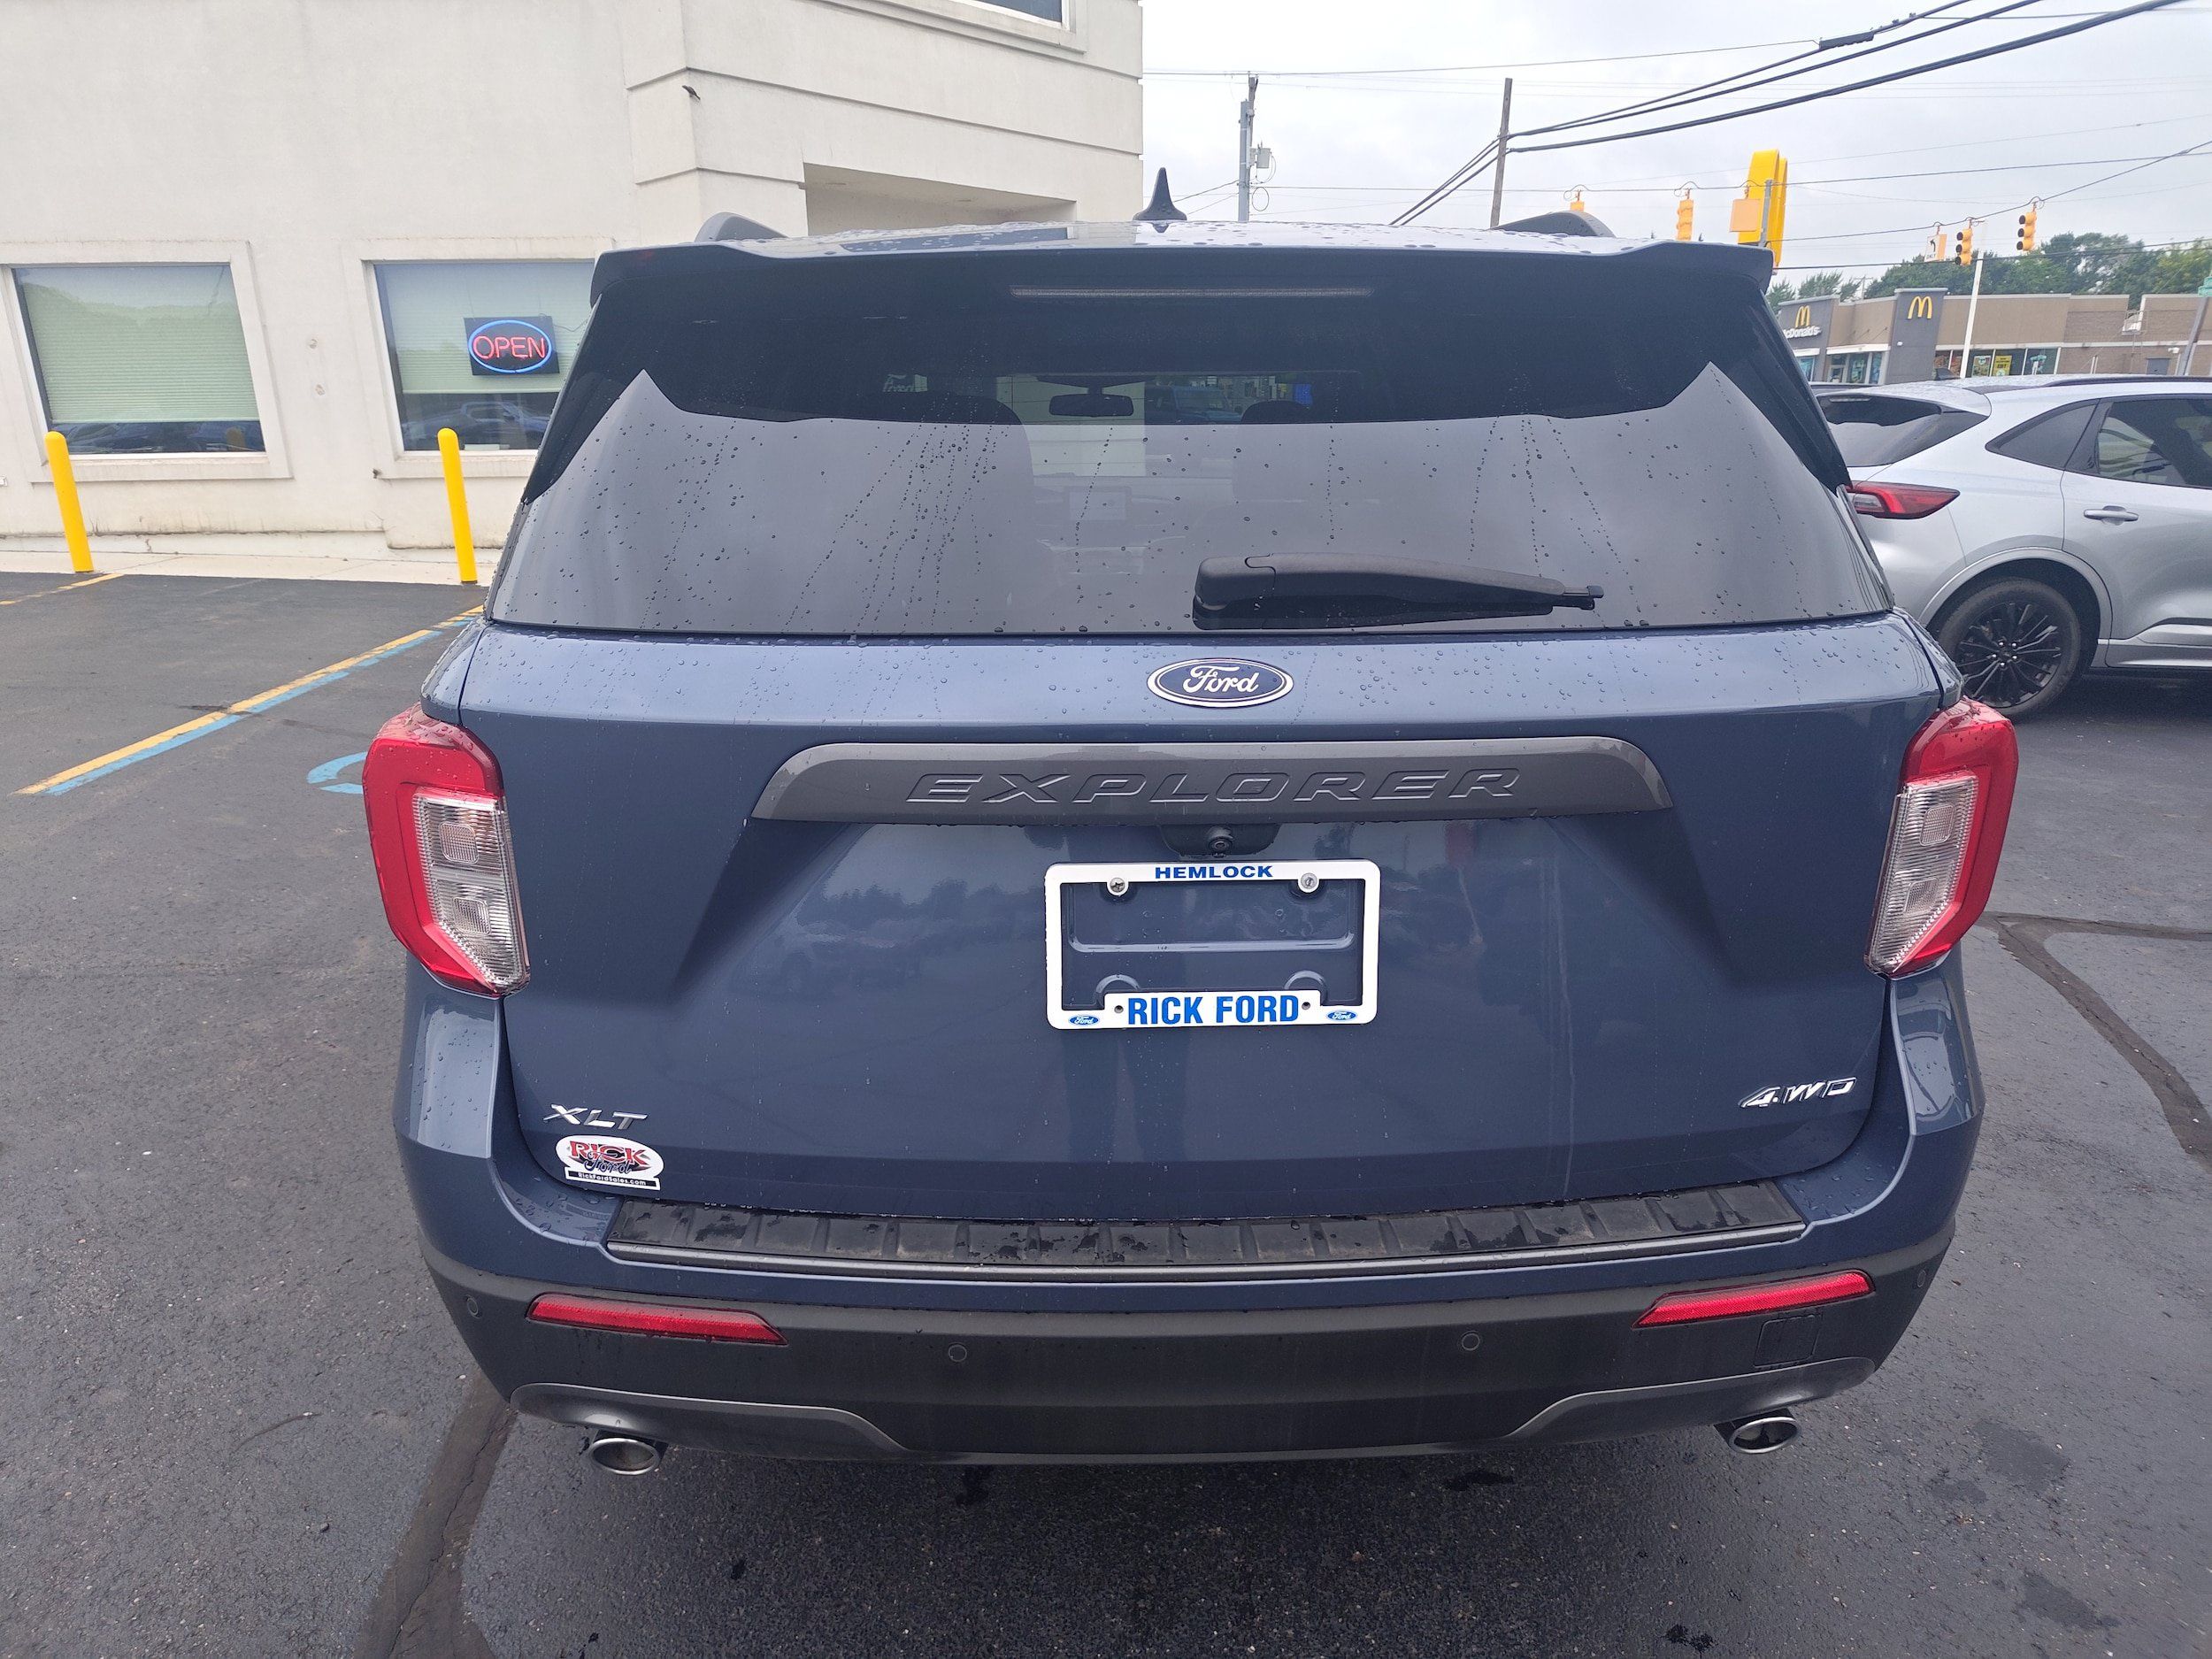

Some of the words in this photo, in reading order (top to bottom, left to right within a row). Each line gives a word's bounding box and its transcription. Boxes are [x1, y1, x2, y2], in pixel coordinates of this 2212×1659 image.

[472, 335, 546, 359] OPEN
[1182, 665, 1258, 695] Ford
[906, 768, 1520, 804] EXPLORER
[1155, 864, 1273, 879] HEMLOCK
[1073, 1016, 1094, 1025] Ford
[1127, 996, 1203, 1025] RICK
[1216, 995, 1299, 1024] FORD
[1332, 1011, 1352, 1020] Ford
[1739, 1077, 1856, 1108] 4WD
[542, 1103, 648, 1130] XLT
[569, 1141, 649, 1167] RICK
[584, 1152, 632, 1174] Ford
